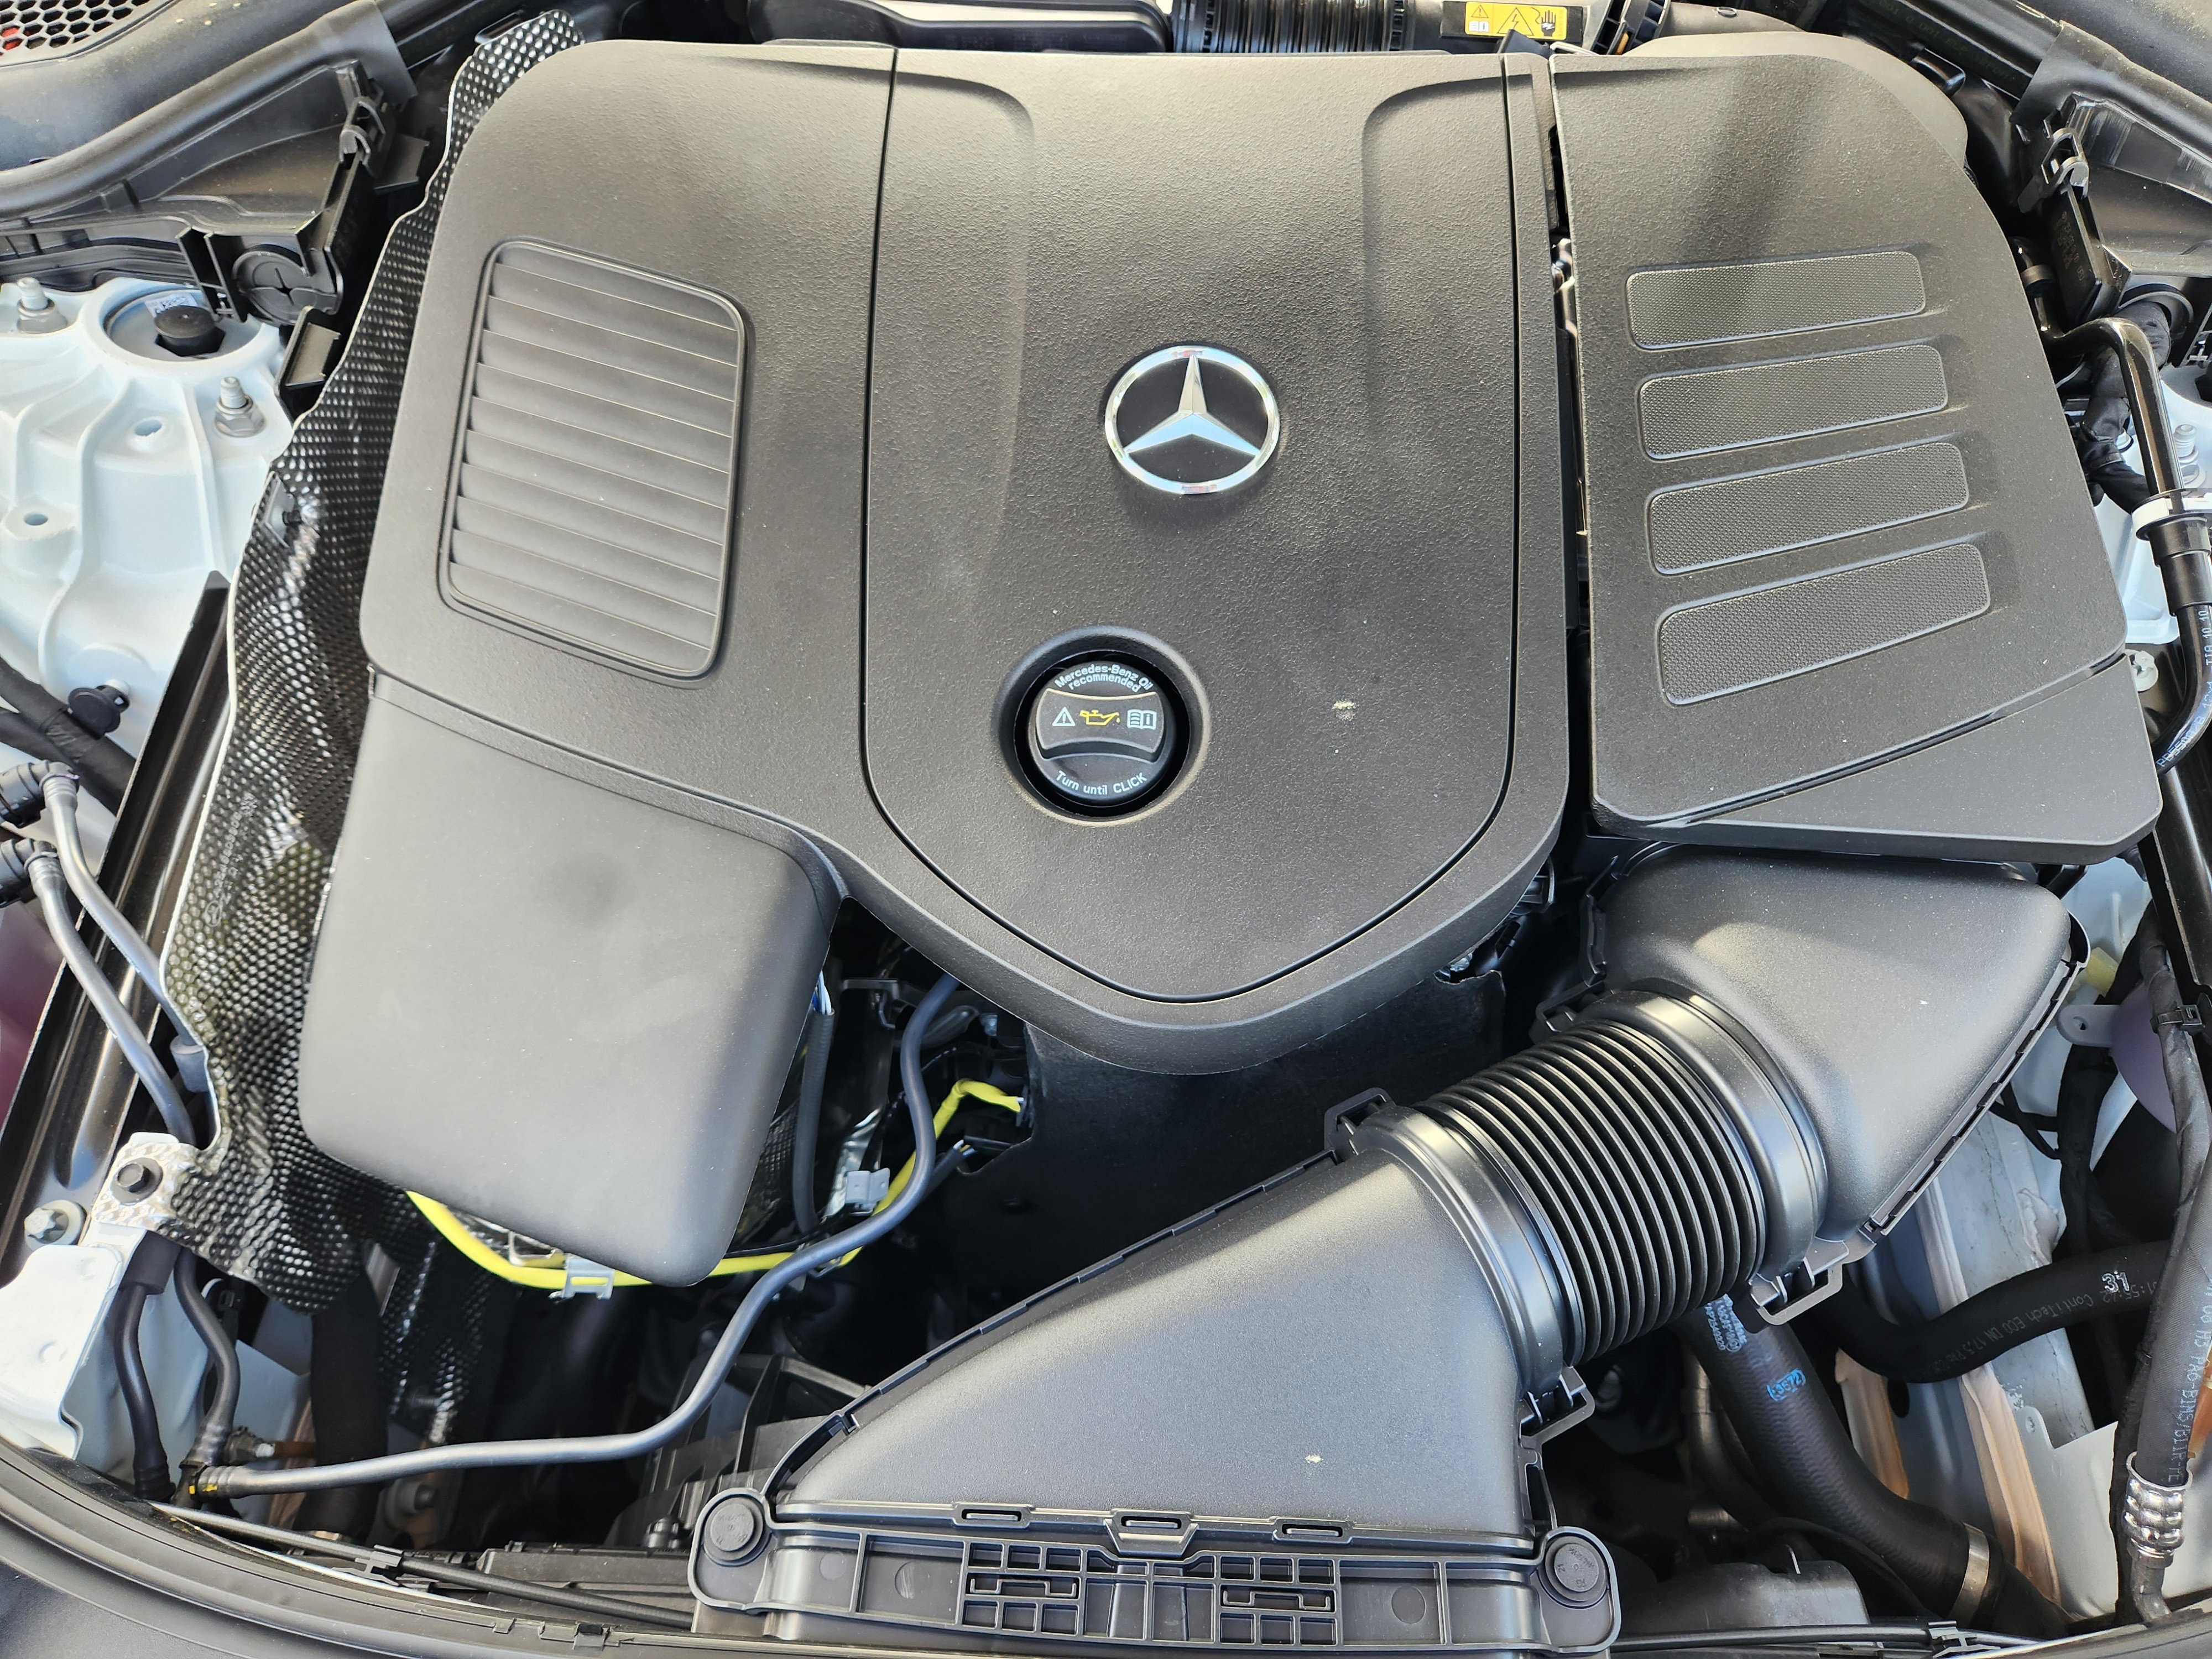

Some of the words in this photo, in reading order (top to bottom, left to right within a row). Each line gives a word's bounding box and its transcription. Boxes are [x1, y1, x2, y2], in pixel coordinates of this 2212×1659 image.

[1054, 664, 1139, 688] Mercedes-Benz
[1139, 677, 1154, 690] Oil
[1068, 673, 1141, 692] recommended
[1056, 770, 1079, 791] Turn
[1083, 784, 1108, 795] until
[1113, 772, 1147, 794] CLICK
[2102, 1271, 2130, 1293] 31
[2026, 1293, 2094, 1323] ContiTech
